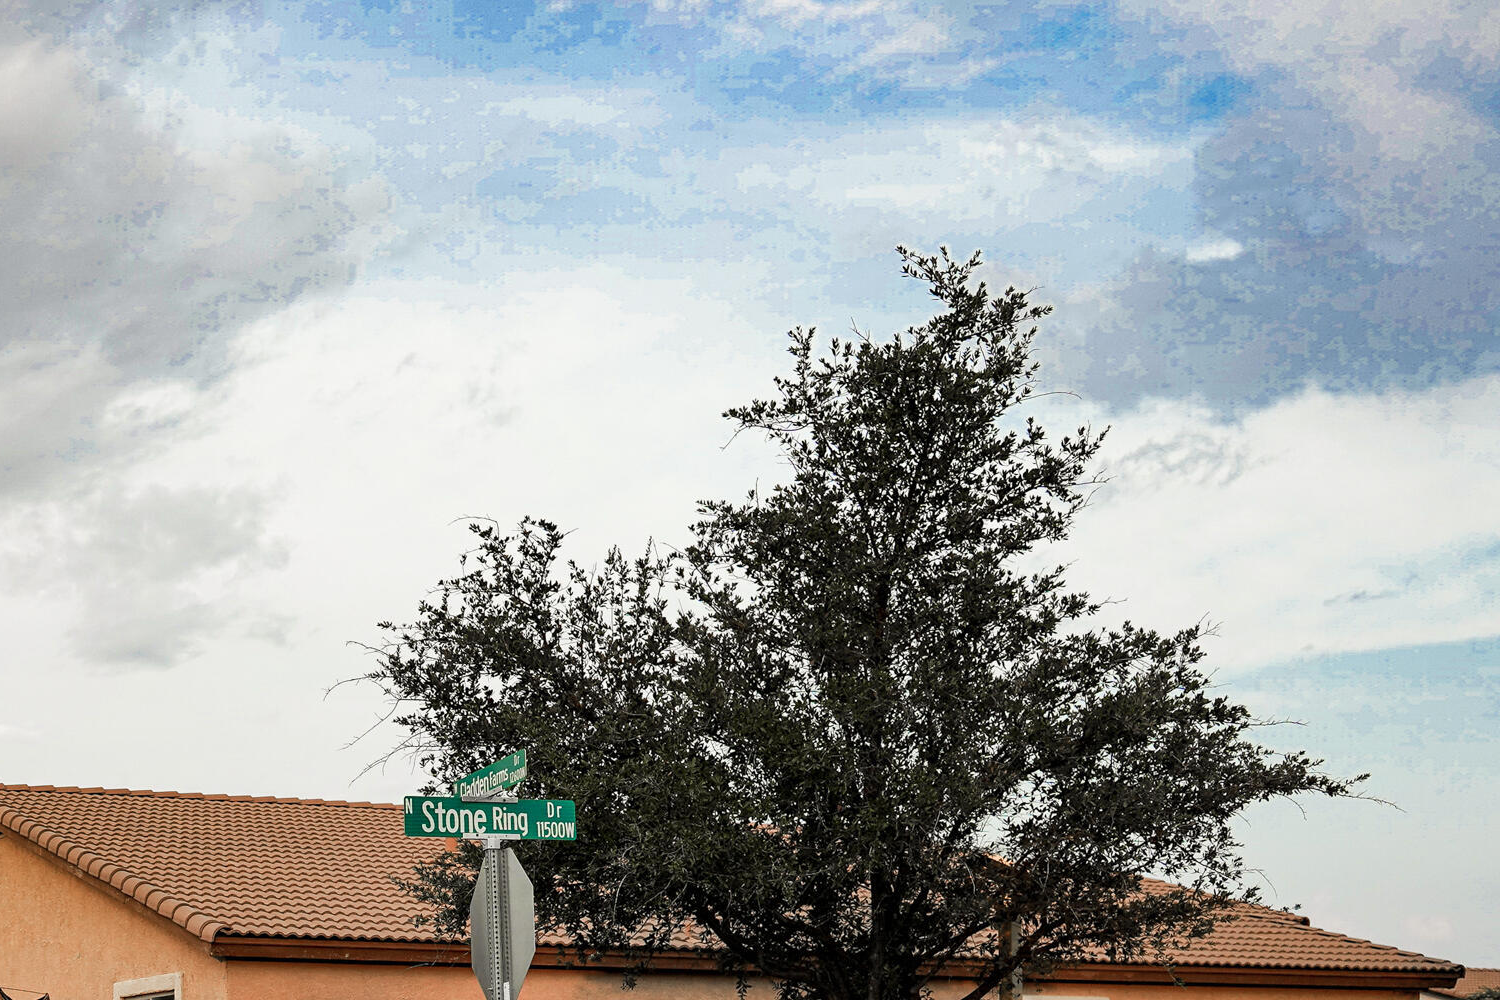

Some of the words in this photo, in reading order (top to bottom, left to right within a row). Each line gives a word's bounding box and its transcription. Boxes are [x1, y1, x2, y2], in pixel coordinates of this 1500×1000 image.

[489, 768, 508, 788] Farms
[513, 755, 520, 766] Dr
[405, 798, 413, 814] N
[421, 801, 487, 834] Stone
[493, 806, 528, 836] Ring
[547, 802, 562, 818] Dr
[536, 821, 575, 838] 11500W
